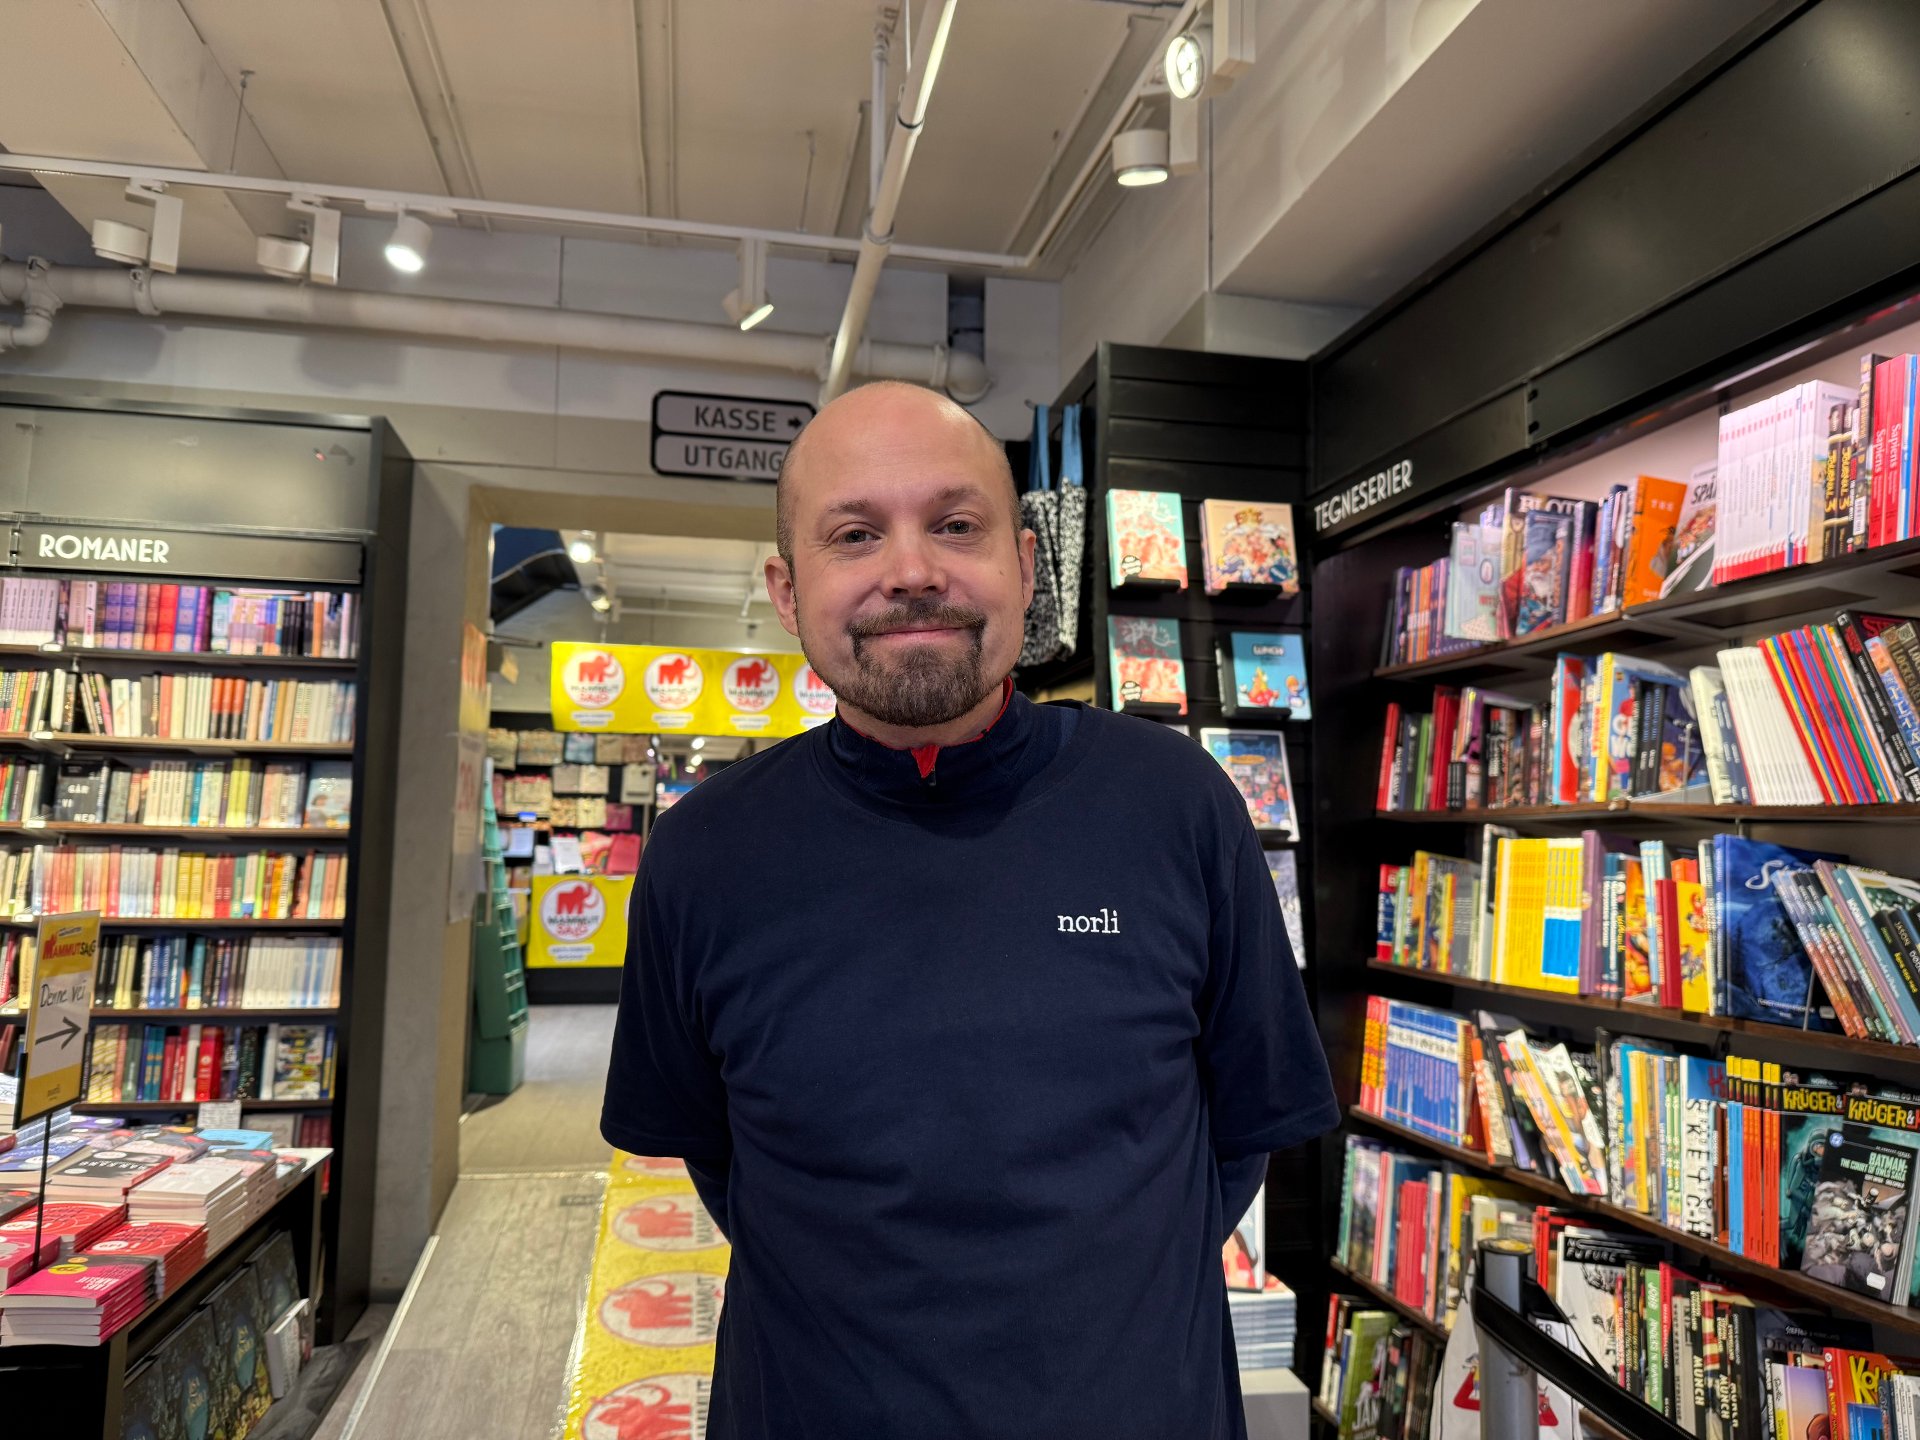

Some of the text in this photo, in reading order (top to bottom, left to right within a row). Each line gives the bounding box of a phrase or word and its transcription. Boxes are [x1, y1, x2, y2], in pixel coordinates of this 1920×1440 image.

[694, 405, 776, 432] KASSE
[684, 444, 782, 472] UTGANG
[1874, 428, 1886, 473] Sapiens
[1888, 423, 1901, 468] Sapiens
[1314, 459, 1413, 532] TEGNESERIER
[39, 534, 170, 564] ROMANER
[799, 690, 834, 699] MAMM
[1057, 908, 1120, 934] norli
[40, 979, 86, 1008] Denne vei
[1783, 1088, 1838, 1113] KRÜGER
[1848, 1098, 1908, 1128] KRÜGER
[1840, 1157, 1850, 1168] THE
[1869, 1152, 1908, 1170] BATMAN:
[1566, 1247, 1617, 1263] FUTURE
[697, 1277, 716, 1336] MAMMUT
[1650, 1318, 1659, 1351] ANDERS
[1650, 1363, 1659, 1401] KVAMMEN
[1693, 1355, 1705, 1406] MUNCH
[1719, 1374, 1730, 1419] MUNCH
